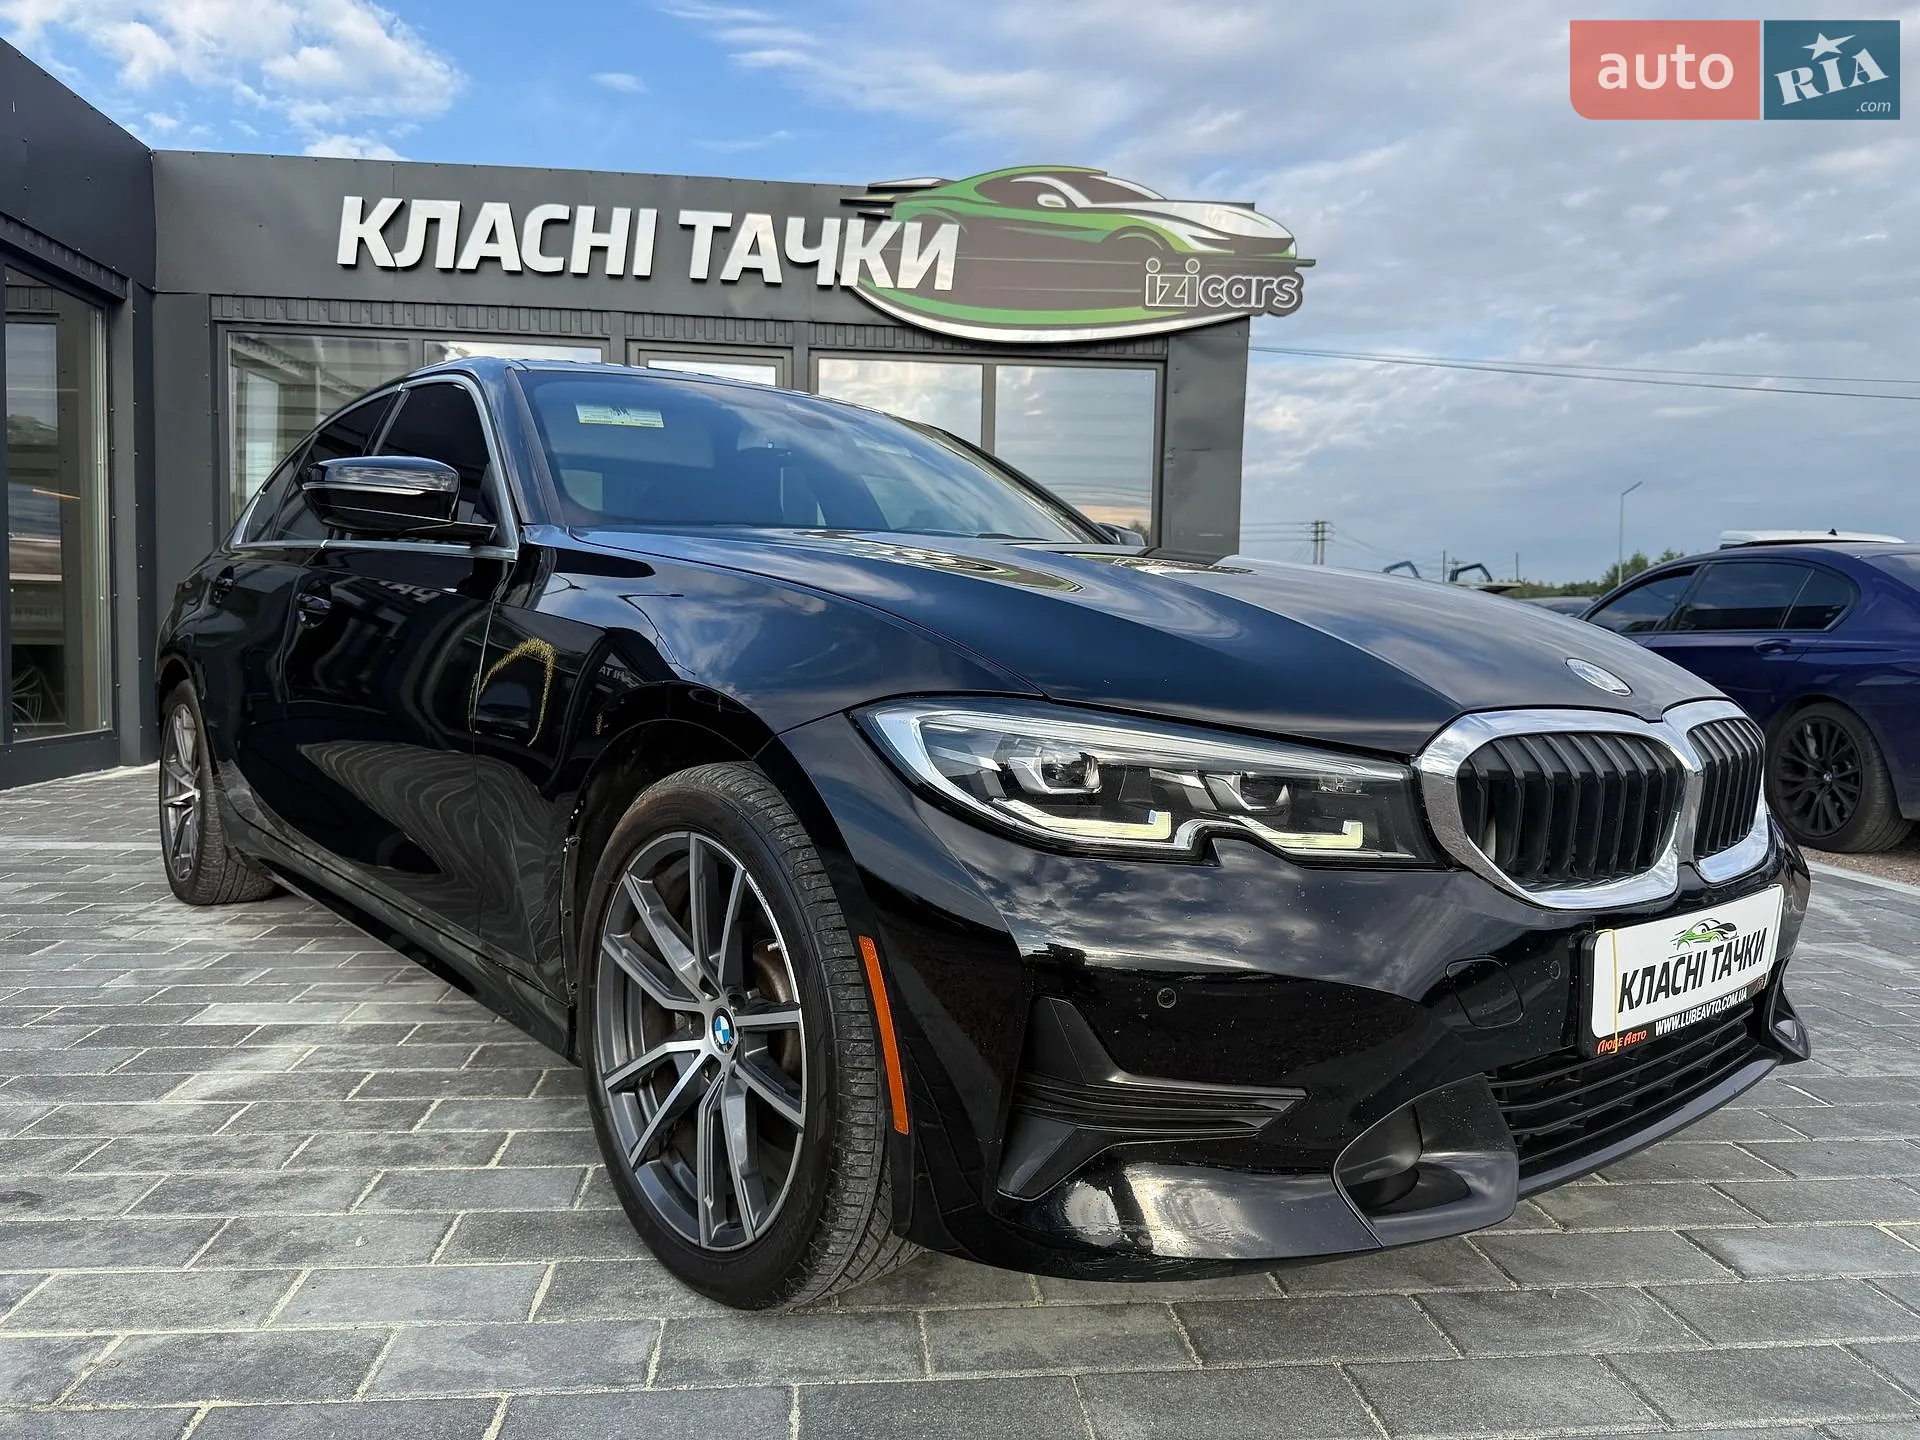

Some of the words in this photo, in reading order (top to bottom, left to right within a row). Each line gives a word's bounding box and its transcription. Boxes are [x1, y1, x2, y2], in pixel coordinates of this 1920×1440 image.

[336, 195, 658, 278] КЛАСНІ
[679, 208, 960, 291] ТАЧКИ
[1618, 948, 1708, 1014] КЛАСНІ
[1711, 927, 1768, 983] ТАЧКИ
[1655, 987, 1748, 1036] WWW.LUBEAVTO.COM.UA
